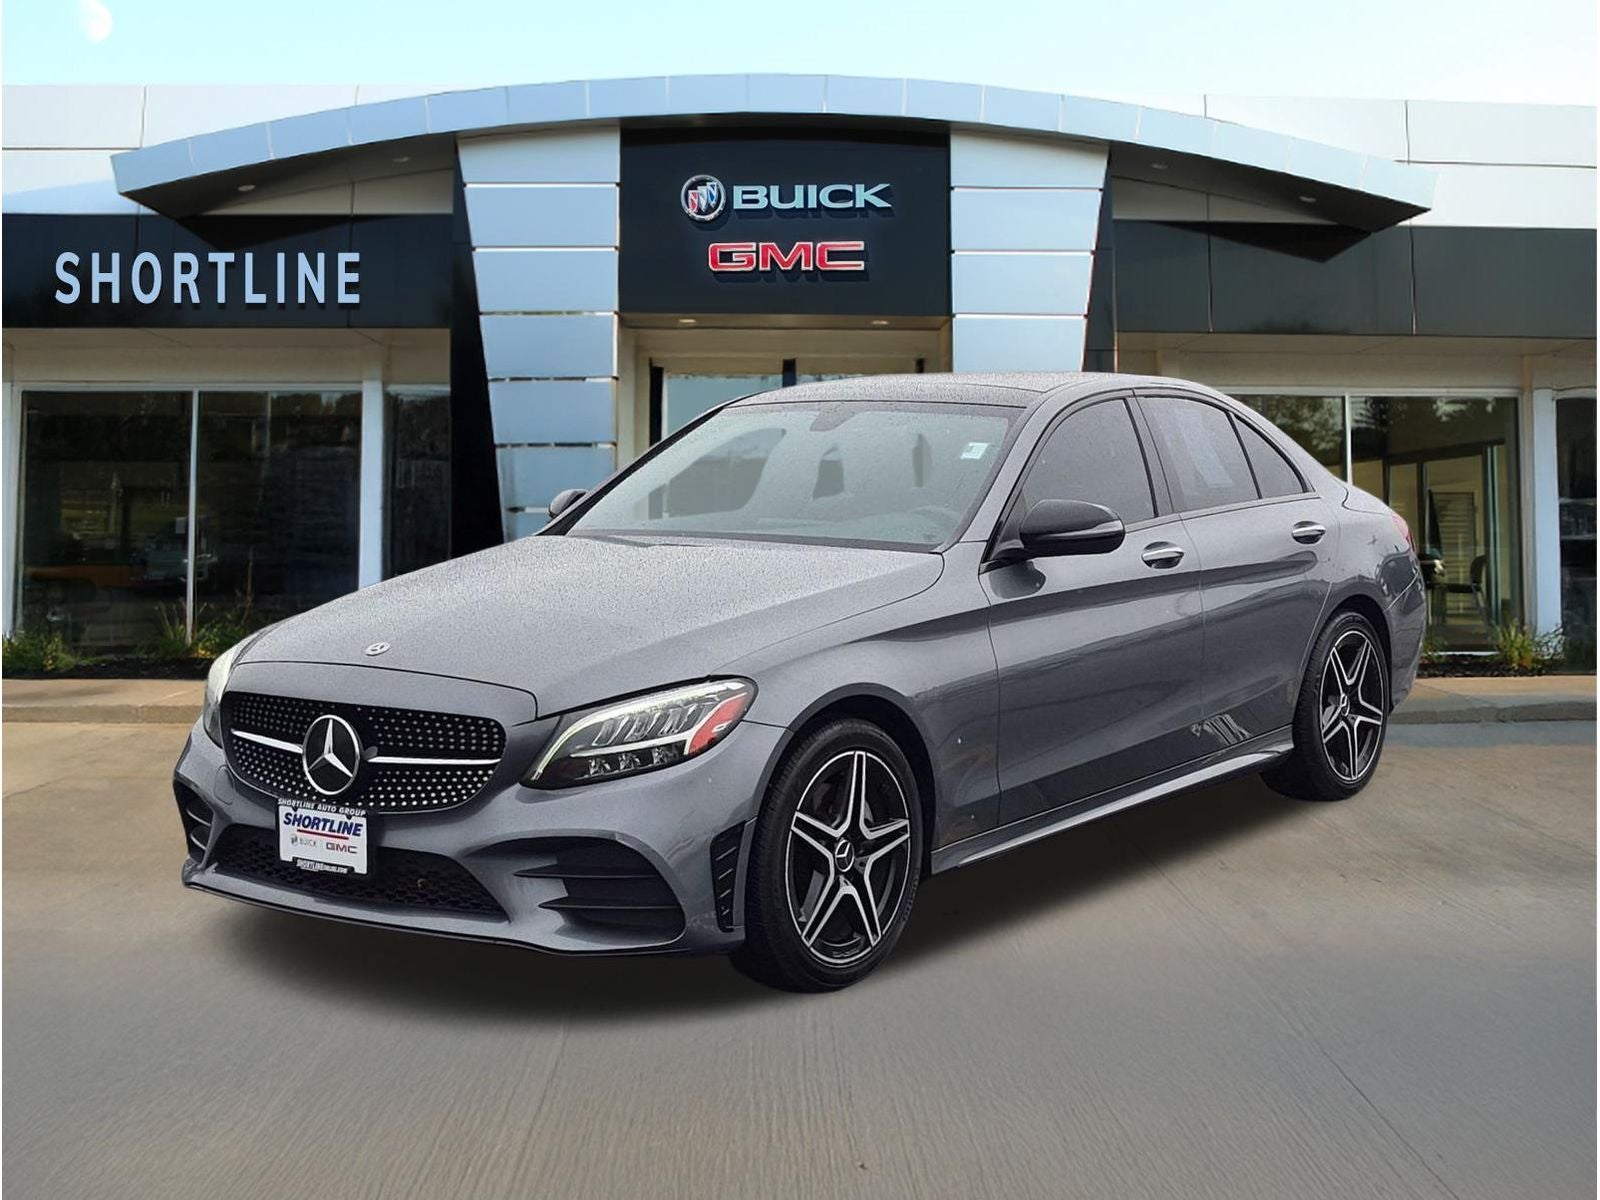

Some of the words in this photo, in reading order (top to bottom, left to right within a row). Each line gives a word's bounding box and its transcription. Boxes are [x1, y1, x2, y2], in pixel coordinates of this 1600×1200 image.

[733, 183, 892, 210] BUICK
[708, 241, 865, 271] GMC
[54, 251, 360, 304] SHORTLINE
[278, 798, 315, 810] SHORTLINE
[317, 803, 337, 812] AUTO
[339, 807, 366, 816] GROUP
[283, 812, 363, 837] SHORTLINE
[326, 842, 358, 854] GMC
